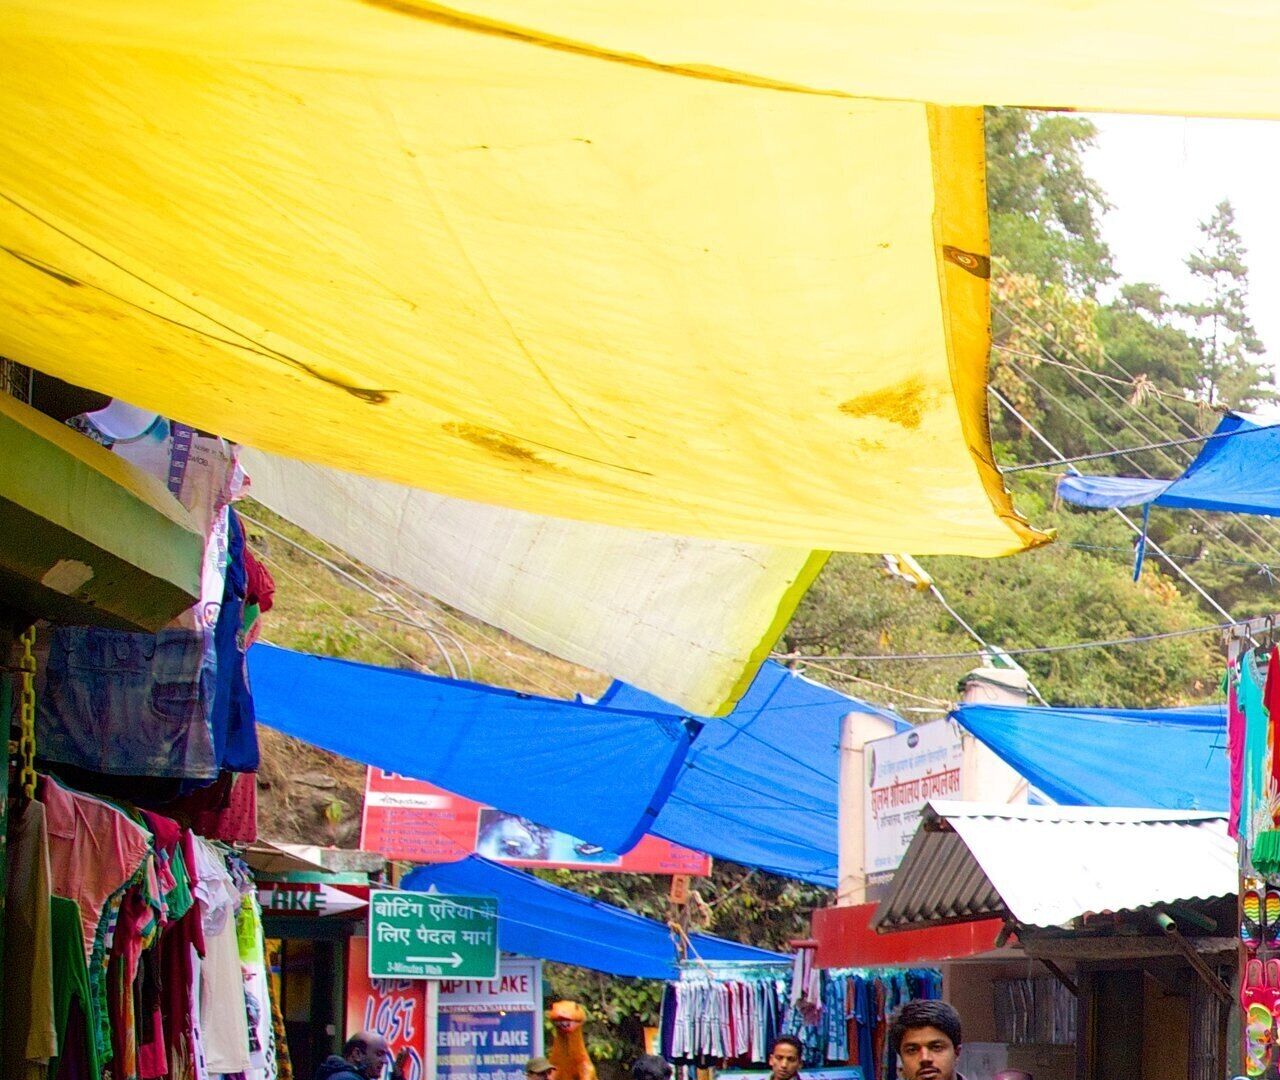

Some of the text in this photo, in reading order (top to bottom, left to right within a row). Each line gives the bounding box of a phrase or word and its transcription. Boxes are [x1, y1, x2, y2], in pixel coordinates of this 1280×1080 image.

[375, 897, 497, 921] बोटिंग एरिया के
[377, 921, 492, 946] लिए पैदल मार्ग
[438, 975, 528, 995] MPTY LAKE
[364, 995, 416, 1043] LOST
[493, 1031, 529, 1047] LAKE
